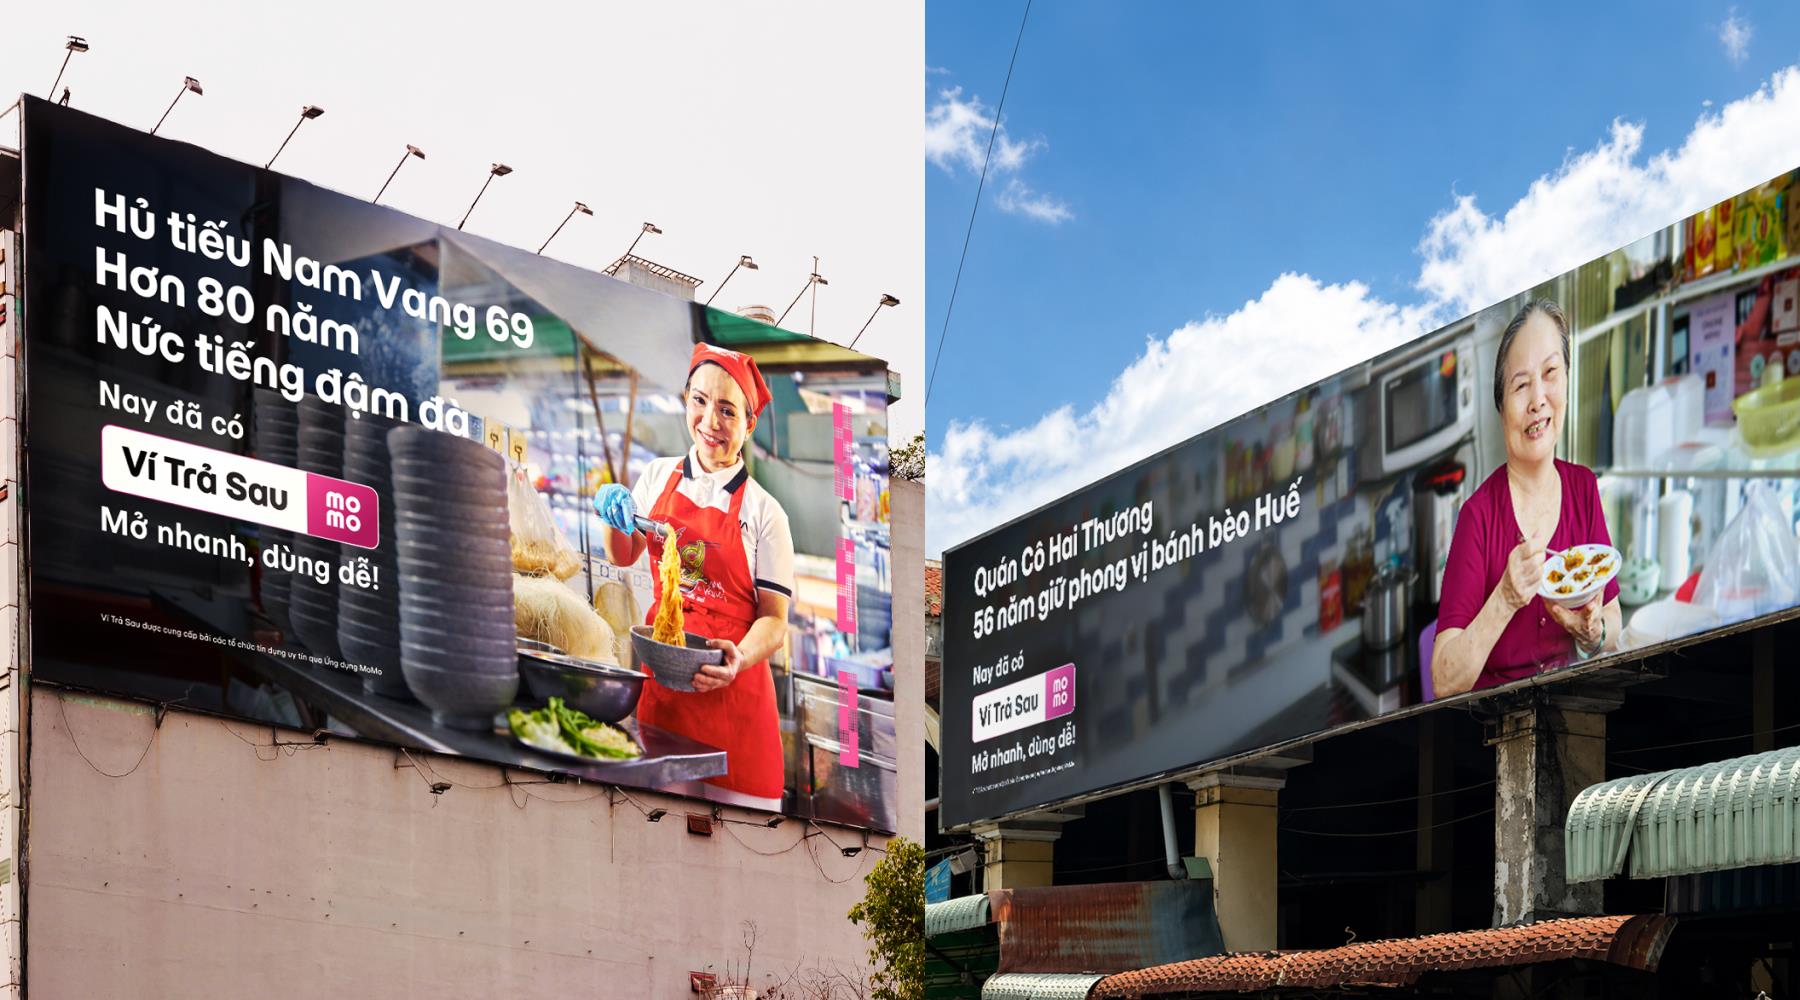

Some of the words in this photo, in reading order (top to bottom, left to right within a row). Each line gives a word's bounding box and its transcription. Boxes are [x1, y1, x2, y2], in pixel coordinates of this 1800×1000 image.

[95, 187, 156, 240] Hủ
[166, 212, 251, 268] tiếu
[262, 237, 362, 301] Nam
[371, 269, 475, 341] Vang
[486, 305, 535, 350] 69
[96, 246, 186, 307] Hơn
[197, 276, 255, 326] 80
[266, 303, 360, 356] năm
[97, 305, 185, 364] Nức
[194, 332, 305, 404] tiếng
[315, 369, 409, 421] đậm
[419, 394, 471, 439] đà
[100, 380, 158, 424] Nay
[166, 399, 203, 431] đã
[211, 412, 244, 440] có
[122, 445, 157, 482] Ví
[164, 456, 218, 496] Trả
[226, 471, 289, 513] Sau
[101, 505, 149, 541] Mở
[158, 522, 255, 568] nhanh,
[262, 543, 331, 585] dùng
[338, 556, 380, 591] dễ!
[973, 604, 995, 639] 56
[997, 595, 1035, 631] năm
[1037, 576, 1068, 621] giữ
[1068, 556, 1128, 609] phong
[1130, 543, 1149, 583] vị
[1151, 521, 1204, 571] bánh
[1208, 508, 1250, 550] bèo
[1254, 476, 1304, 531] Huế
[974, 556, 1018, 597] Quán
[1020, 543, 1045, 577] Cô
[1049, 528, 1078, 567] Hai
[1081, 500, 1153, 550] Thương
[100, 613, 110, 622] Ví
[125, 618, 141, 628] Sau
[163, 627, 182, 638] cung
[360, 663, 383, 676] MoMo
[973, 664, 993, 686] Nay
[995, 655, 1009, 678] đã
[1011, 649, 1024, 671] có
[972, 750, 989, 774] Mở
[990, 741, 1026, 769] nhanh,
[1028, 735, 1056, 757] dùng
[1058, 721, 1076, 748] dễ!
[979, 703, 991, 727] Ví
[993, 696, 1012, 722] Trả
[1015, 693, 1038, 716] Sau
